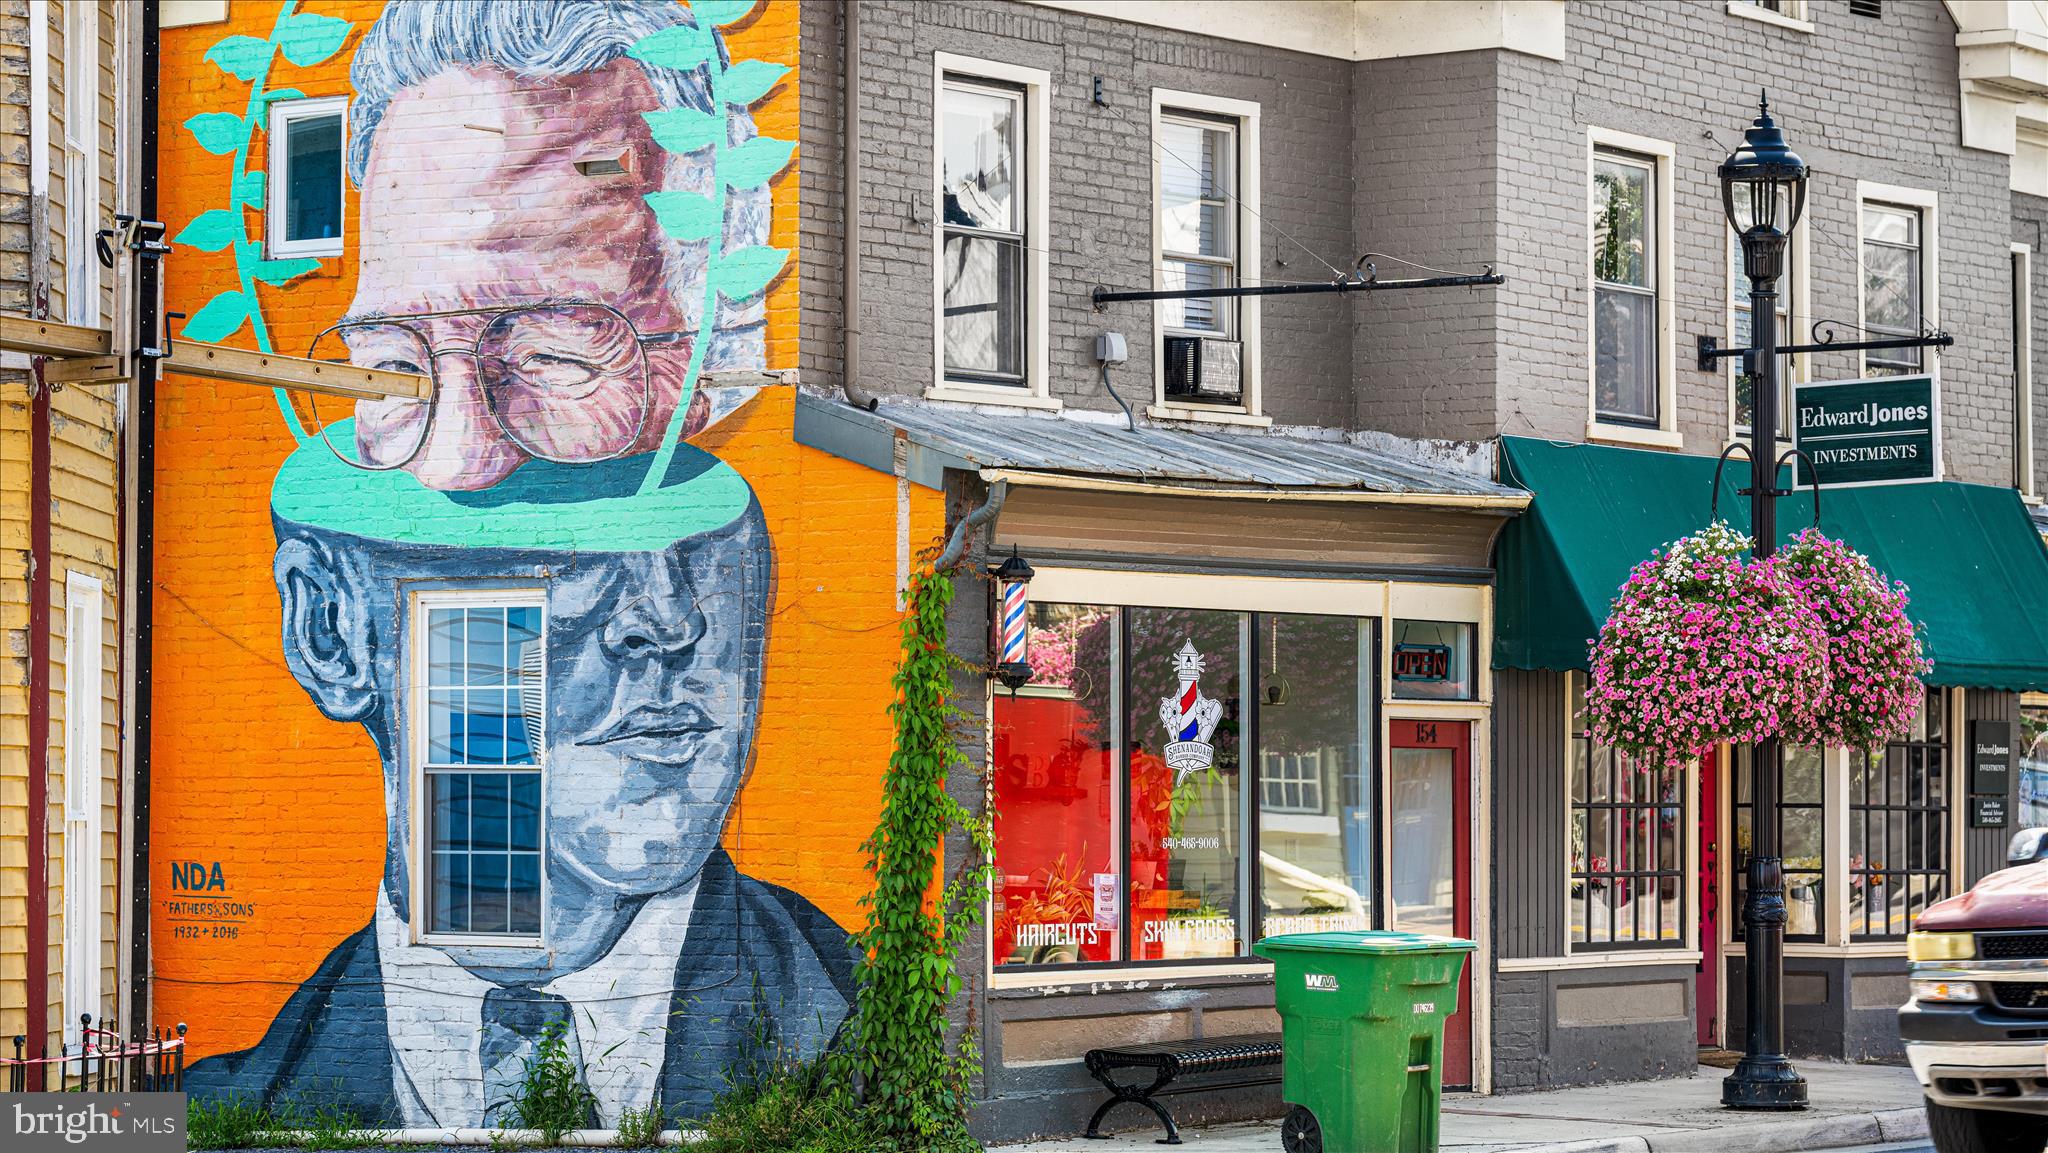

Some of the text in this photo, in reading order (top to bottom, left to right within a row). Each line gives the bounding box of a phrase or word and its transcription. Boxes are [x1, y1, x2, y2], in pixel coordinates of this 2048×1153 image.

[1814, 444, 1918, 465] INVESTMENTS
[1393, 652, 1447, 676] OPEN
[1416, 722, 1437, 743] 154
[1167, 743, 1212, 761] SHENANDOAH
[1979, 764, 2006, 772] INVESTMENTS
[171, 861, 226, 892] NDA
[174, 926, 200, 939] 1932
[212, 926, 239, 940] 2016
[1016, 922, 1099, 947] HAIRCUTS
[1144, 918, 1236, 943] SKIN FADES
